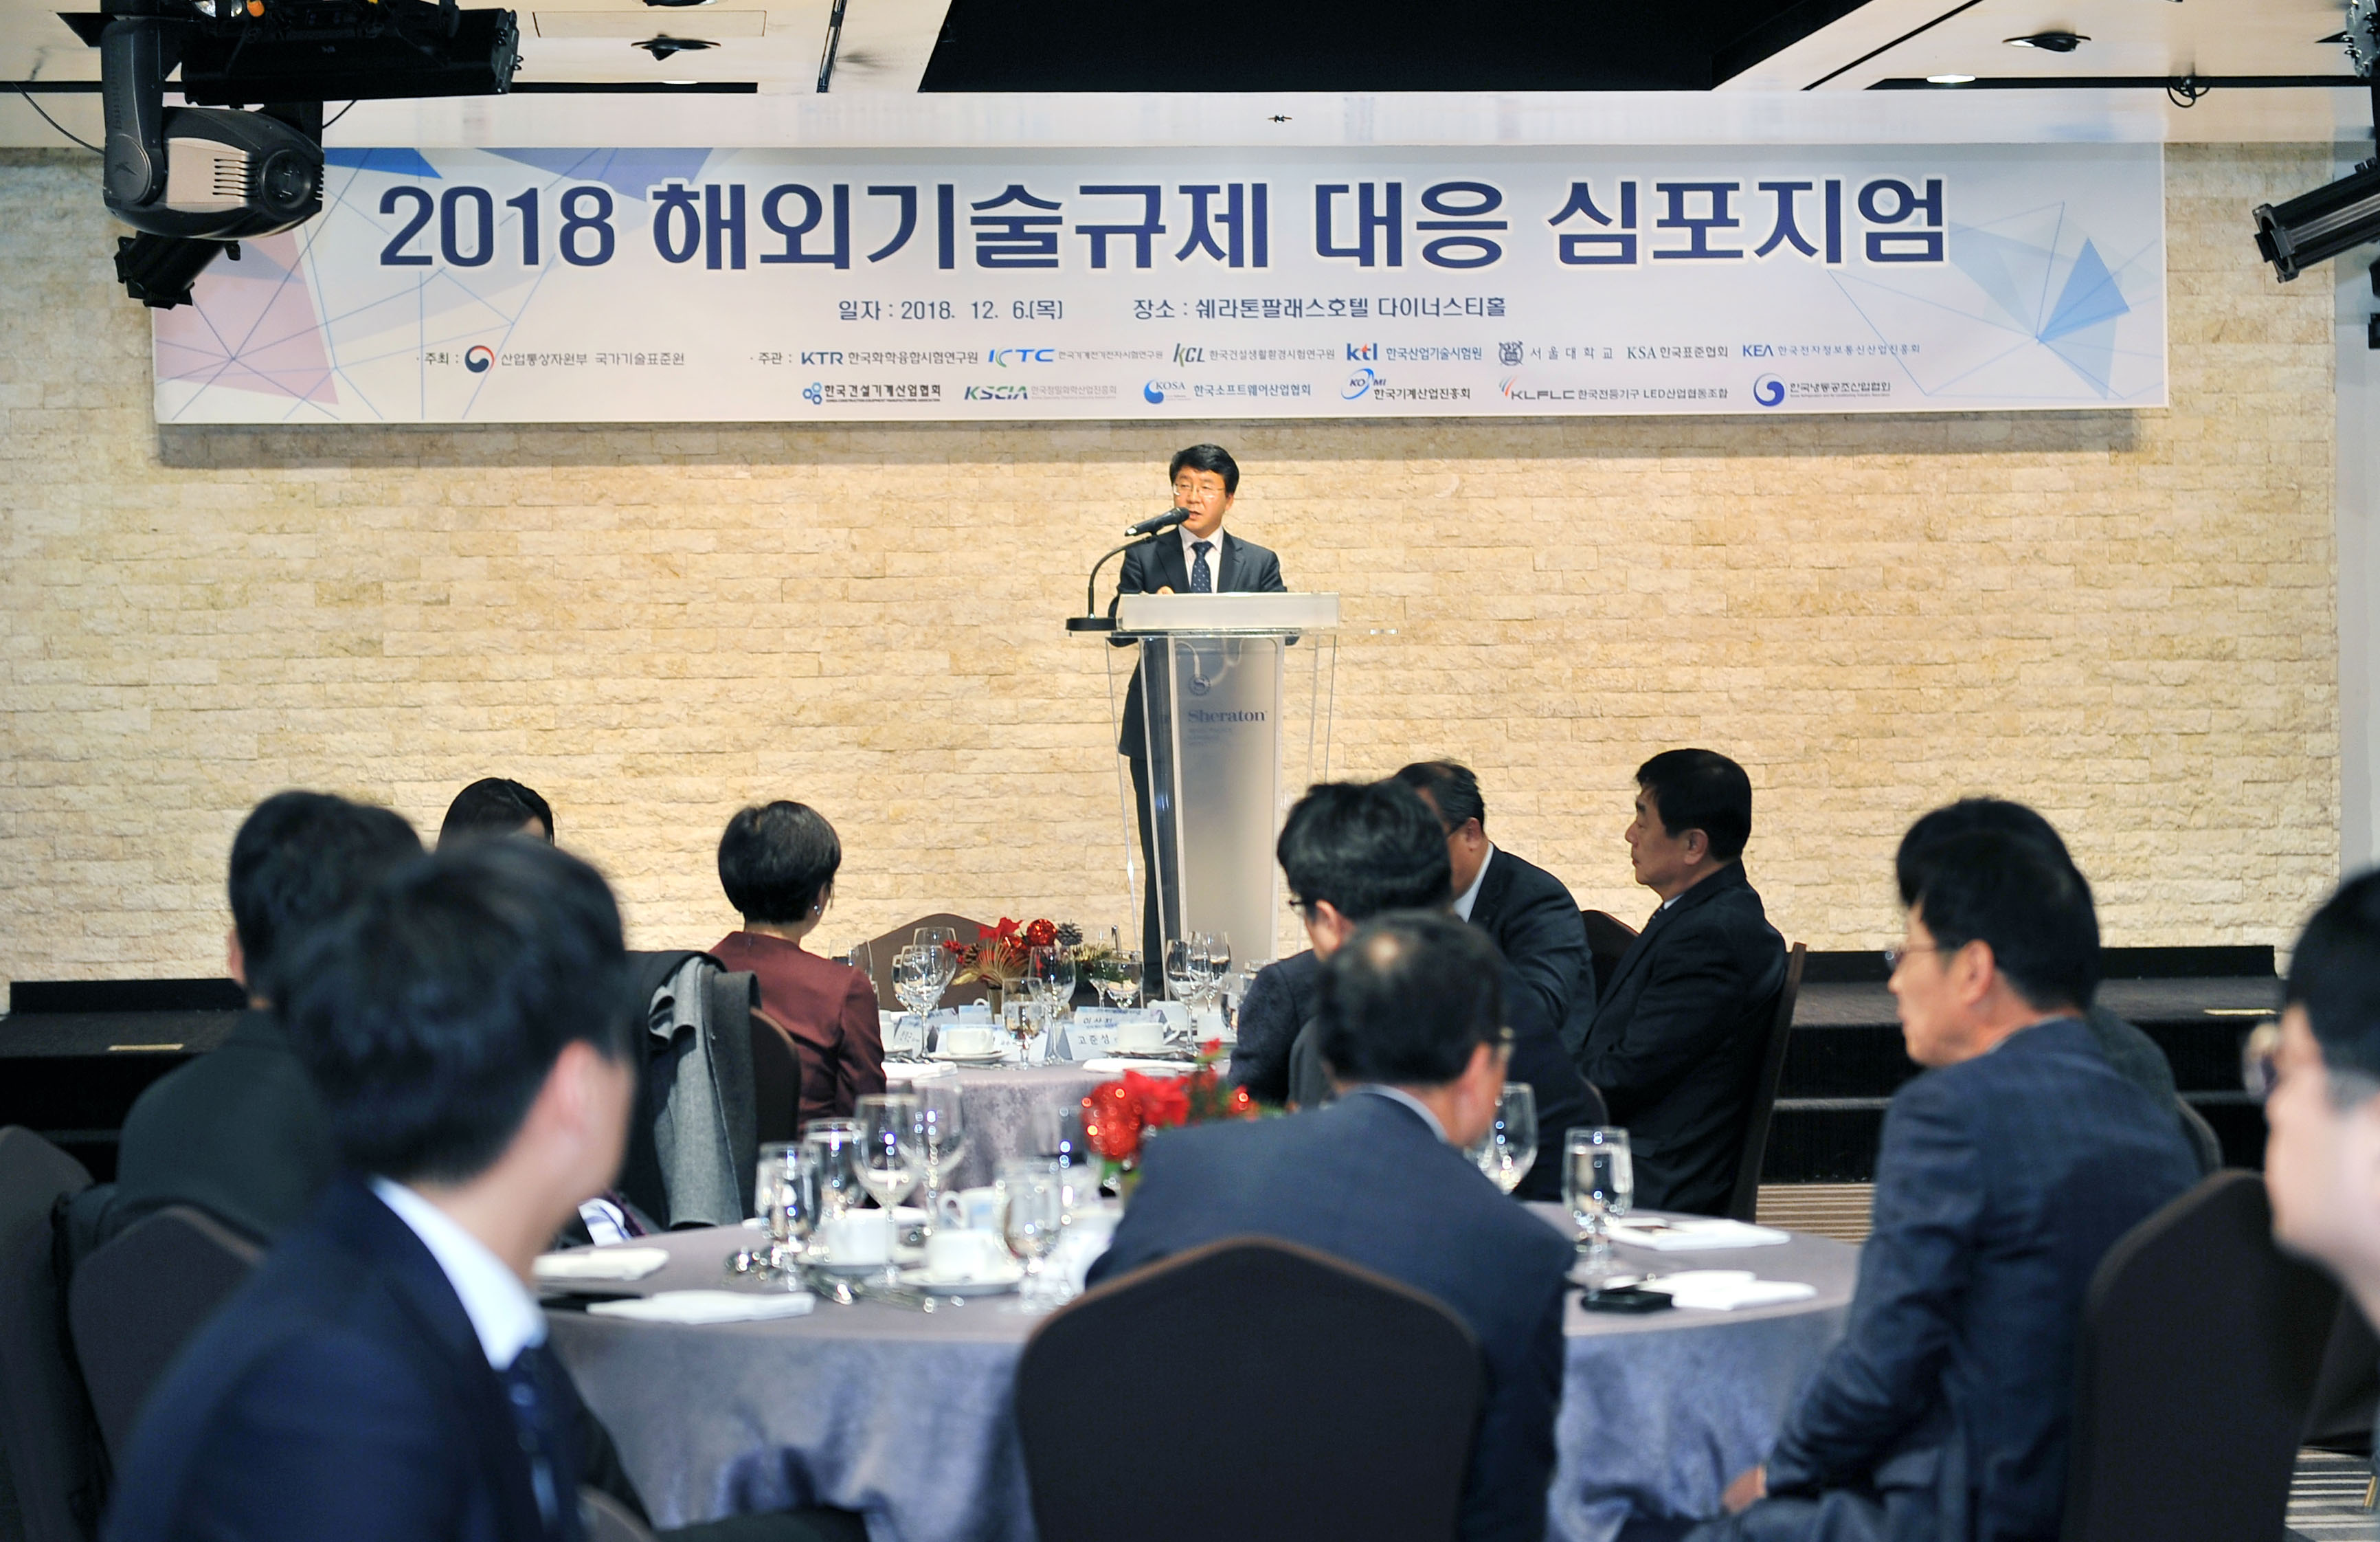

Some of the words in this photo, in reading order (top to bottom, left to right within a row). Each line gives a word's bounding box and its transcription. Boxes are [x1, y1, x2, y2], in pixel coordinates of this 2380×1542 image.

[378, 183, 616, 267] 2018
[651, 181, 1268, 271] 해외기술규제
[1315, 181, 1508, 269] 대응
[1547, 178, 1944, 265] 심포지엄
[839, 300, 881, 321] 일자
[901, 300, 955, 320] 2018.
[971, 300, 998, 320] 12.
[1134, 299, 1175, 320] 장소
[1195, 298, 1368, 319] 쉐라톤팔래스호텔
[1378, 297, 1505, 317] 다이너스티홀
[758, 352, 783, 365] 주관
[801, 351, 843, 365] KTR
[848, 351, 978, 365] 한국화학융합시험연구원
[1209, 348, 1335, 361] 한국건설생활환경시험연구원
[1347, 342, 1378, 361] ktl
[1386, 346, 1482, 361] 한국산업기술시험원
[1627, 346, 1657, 359] KSA
[1659, 346, 1728, 359] 한국표준협회
[425, 352, 449, 366] 주최
[501, 353, 587, 367] 산업통상자원부
[595, 352, 684, 366] 국가기술표준원
[824, 383, 941, 399] 한국건설기계산업협회
[964, 386, 1028, 400] KSCIA
[1156, 381, 1187, 391] KOSA
[1193, 383, 1311, 397] 한국소프트웨어산업협회
[1373, 388, 1470, 401] 한국기계산업진흥회
[1511, 390, 1575, 401] KLFLC
[1187, 708, 1266, 722] Sheraton
